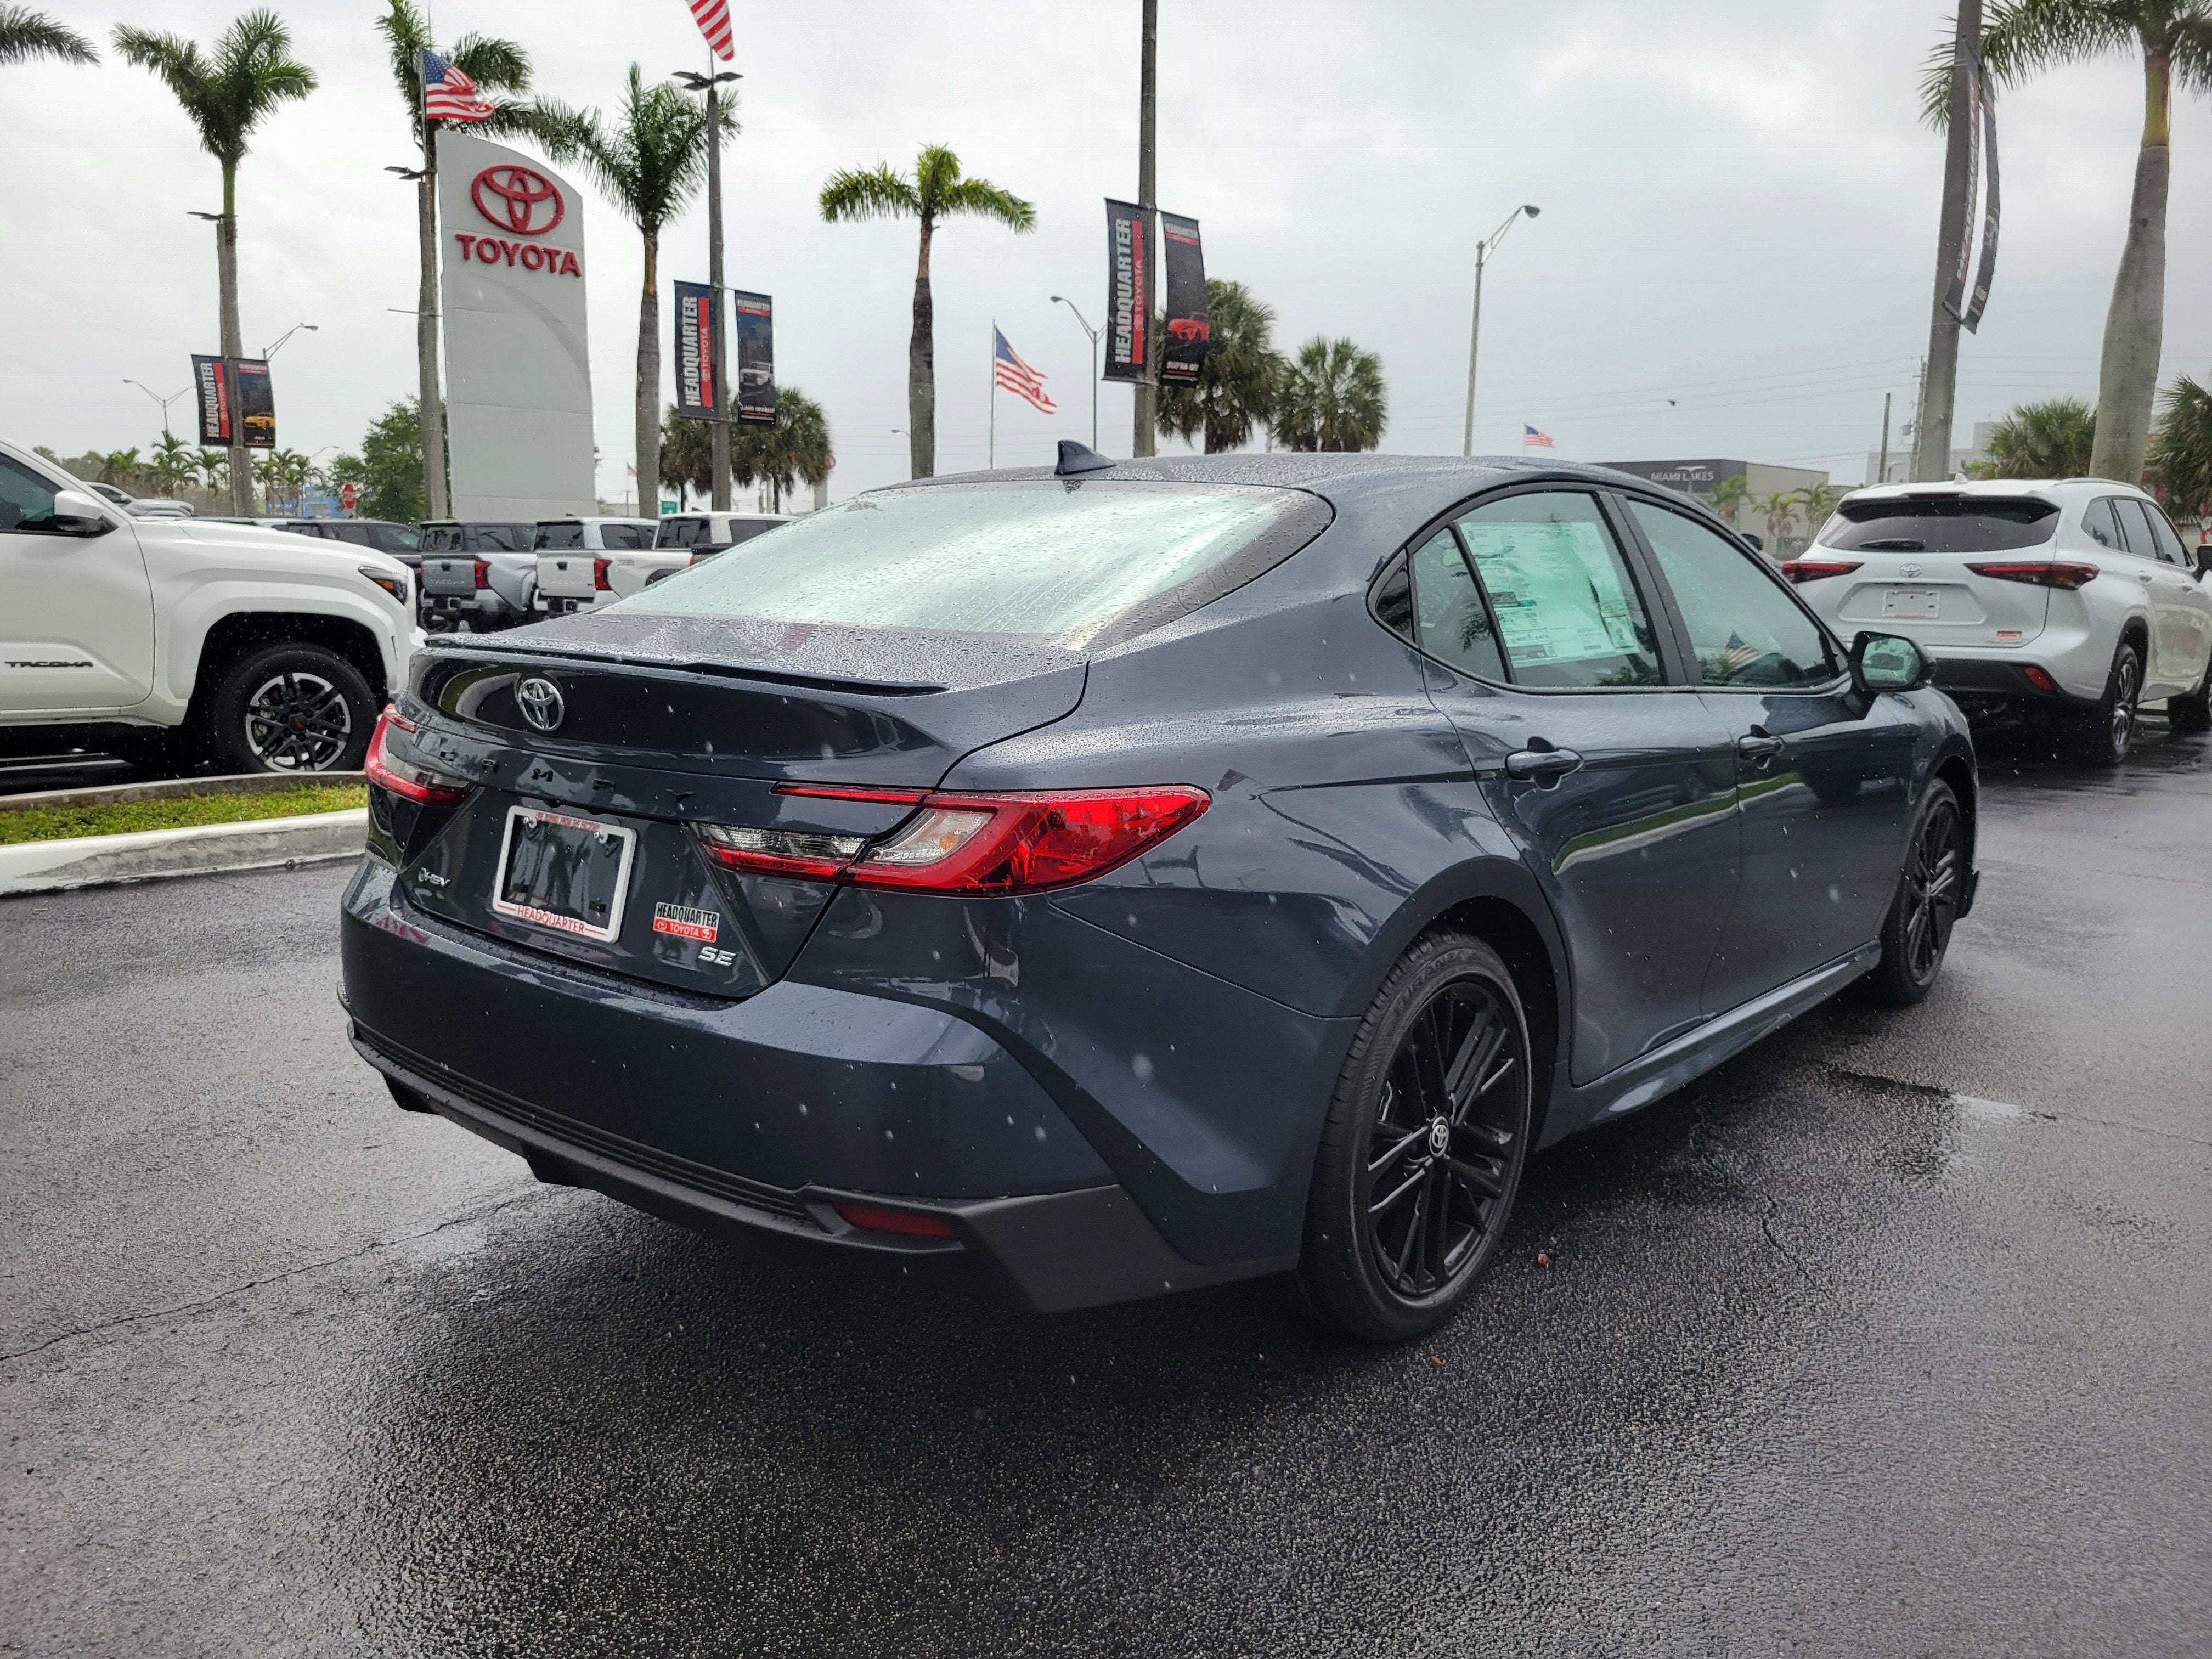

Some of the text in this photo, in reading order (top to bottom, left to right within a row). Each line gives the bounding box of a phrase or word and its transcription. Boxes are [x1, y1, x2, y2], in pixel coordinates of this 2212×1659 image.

[455, 233, 582, 278] TOYOTA
[1115, 218, 1133, 363] HEADQUARTER
[1134, 260, 1144, 312] TOYOTA
[681, 296, 701, 407] HEADQUARTER
[701, 328, 709, 368] TOYOTA
[200, 362, 219, 438] HEADQUARTER
[1651, 471, 1680, 482] MIAMI
[517, 905, 585, 933] HEADQUARTER
[656, 903, 718, 928] HEADQUARTER
[669, 923, 699, 937] TOYOTA
[697, 946, 737, 967] SE
